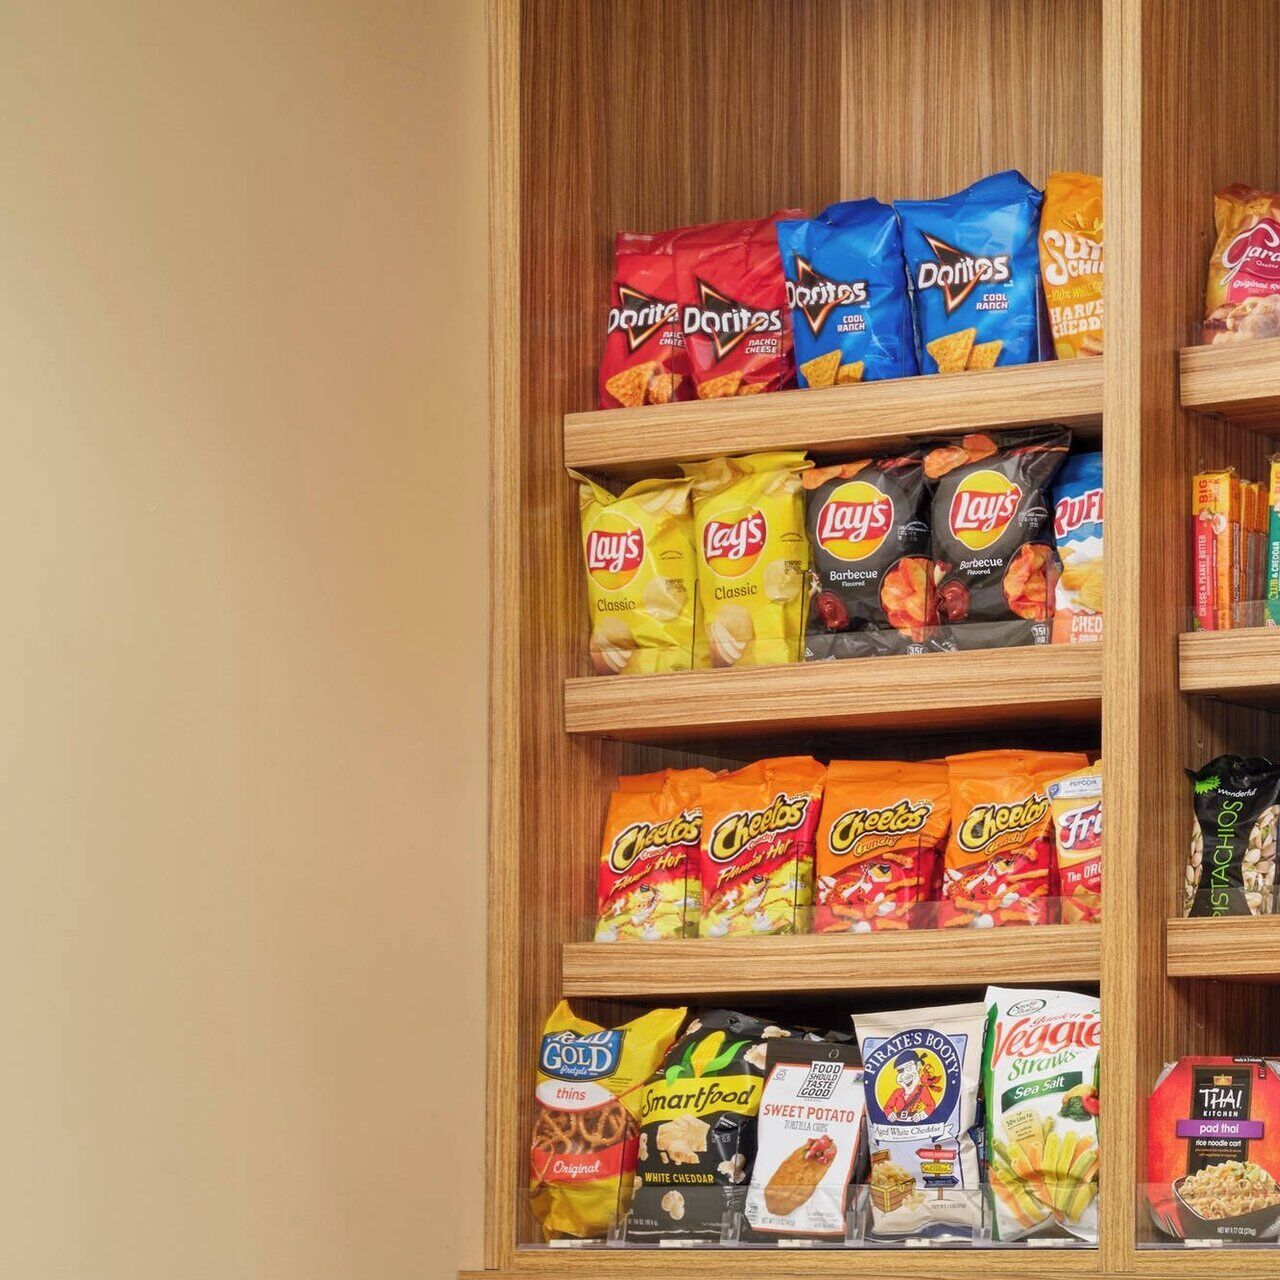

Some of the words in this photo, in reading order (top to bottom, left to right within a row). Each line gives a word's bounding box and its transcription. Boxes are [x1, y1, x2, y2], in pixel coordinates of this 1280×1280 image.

[918, 256, 1010, 289] Doritos
[786, 281, 867, 309] Doritos
[977, 301, 1008, 309] RANCH
[684, 307, 782, 333] Doritos
[1199, 480, 1207, 503] BIG
[960, 556, 1003, 570] Barbecue
[830, 568, 878, 582] Barbecue
[714, 583, 758, 600] Classic
[597, 598, 636, 611] Classic
[1217, 787, 1258, 798] Wonderful
[711, 795, 807, 860] Cheetos
[831, 800, 930, 851] Cheetos
[543, 1043, 612, 1073] GOLD
[1008, 1051, 1076, 1081] Straws
[812, 1064, 841, 1073] FOOD
[556, 1087, 586, 1100] thins
[1014, 1085, 1040, 1100] Sea
[1042, 1077, 1064, 1091] Salt
[643, 1084, 755, 1118] Smartfood
[1200, 1088, 1242, 1109] THAI
[764, 1104, 803, 1118] SWEET
[807, 1106, 854, 1123] POTATO
[1200, 1123, 1218, 1136] pad
[1221, 1123, 1239, 1134] thai
[554, 1160, 600, 1177] Original
[645, 1172, 670, 1184] WHITE
[673, 1173, 714, 1184] CHEDDAR
